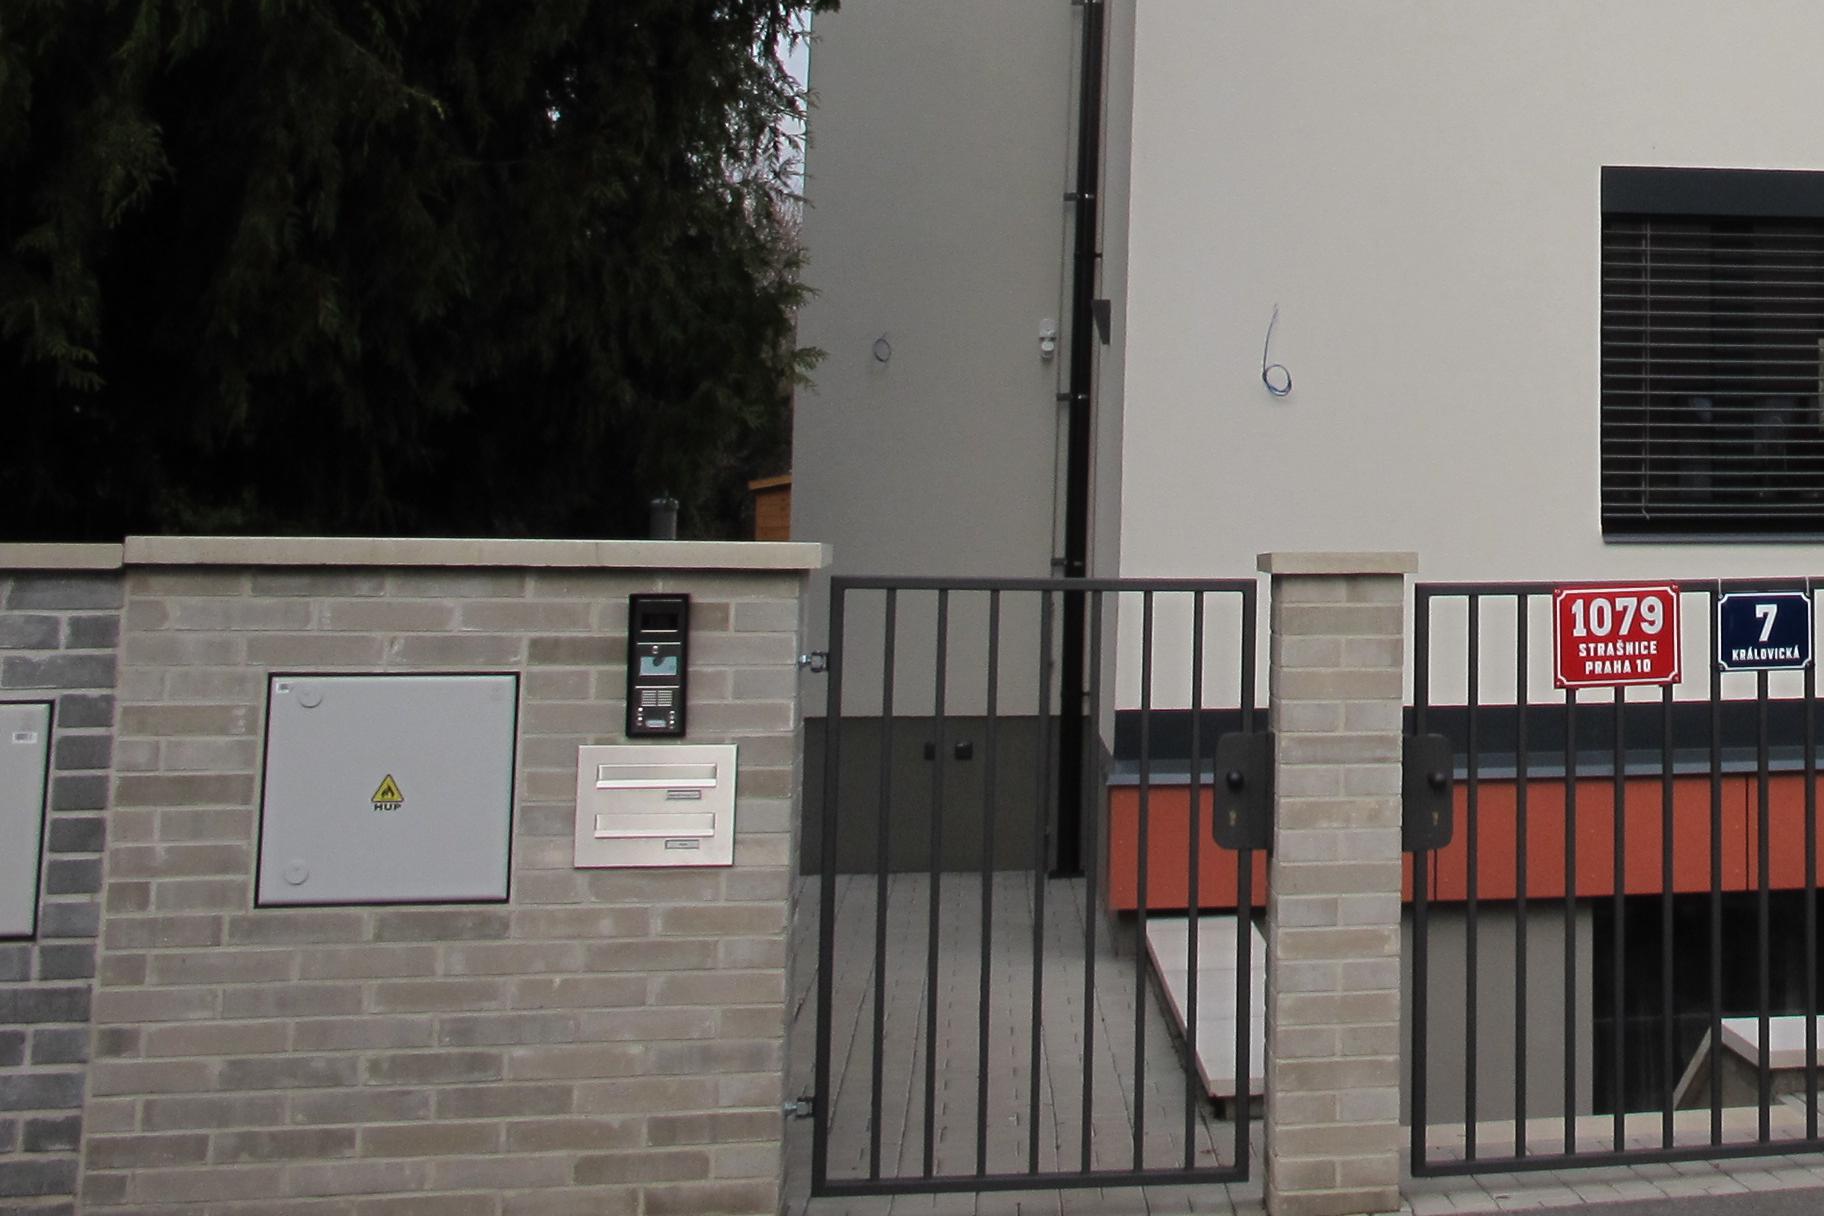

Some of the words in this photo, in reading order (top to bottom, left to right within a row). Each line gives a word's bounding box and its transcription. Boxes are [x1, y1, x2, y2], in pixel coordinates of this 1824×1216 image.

[1571, 595, 1664, 637] 1079
[1755, 603, 1778, 642] 7
[1578, 639, 1658, 657] STRAŠNICE
[1731, 644, 1801, 661] KRÁLOVICKÁ
[1585, 659, 1632, 675] PRAHA
[1636, 658, 1652, 673] 10
[374, 803, 402, 811] HUP
